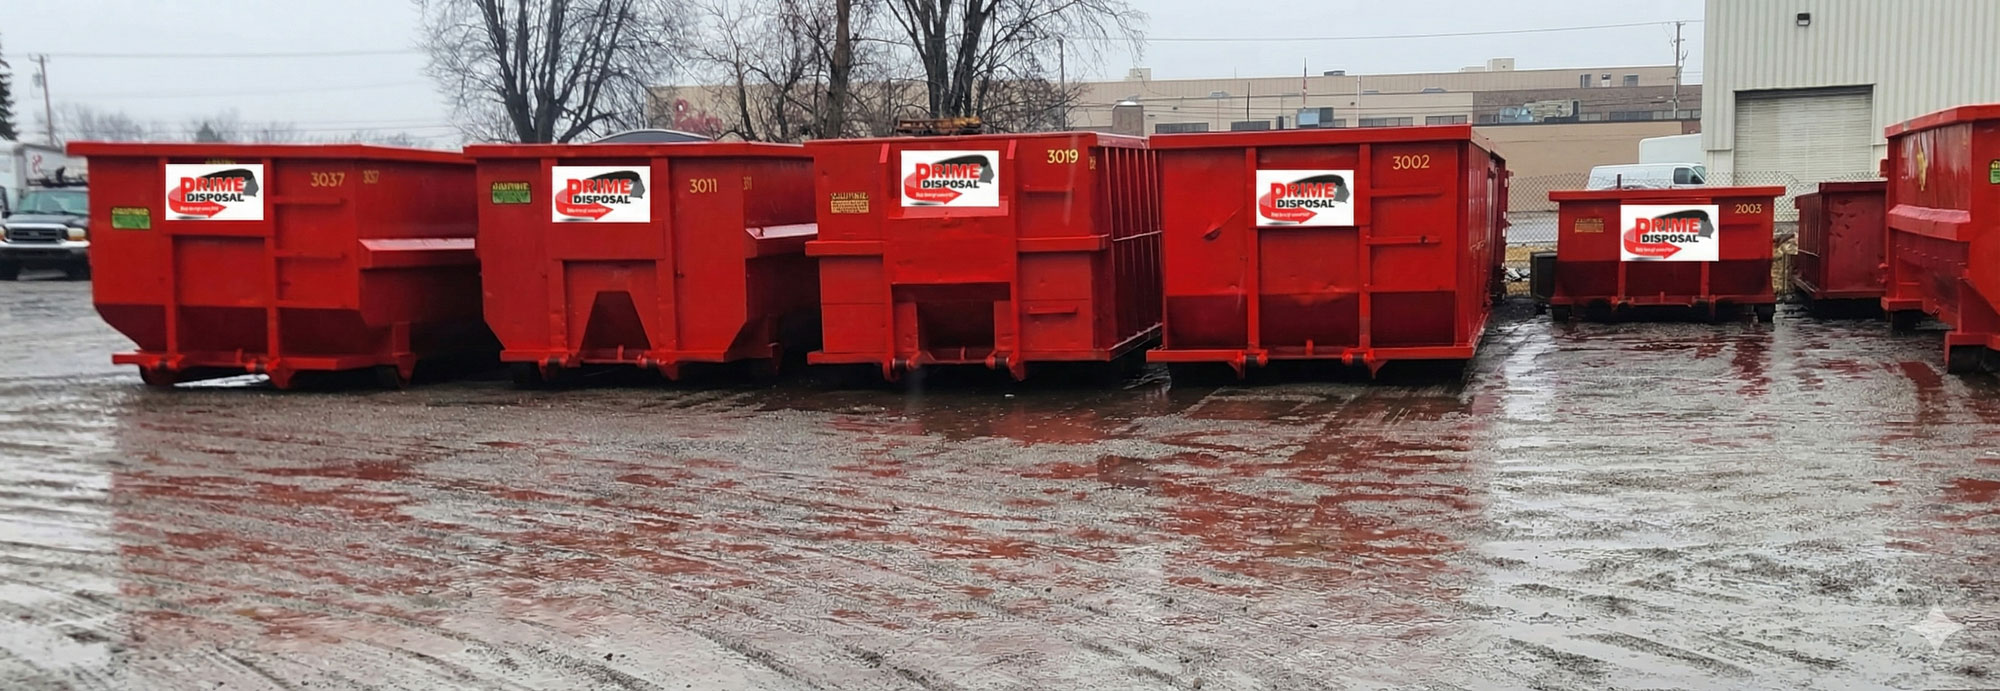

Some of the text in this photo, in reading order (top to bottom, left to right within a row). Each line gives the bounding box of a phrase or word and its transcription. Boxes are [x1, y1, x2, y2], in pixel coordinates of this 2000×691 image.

[1047, 149, 1079, 164] 3019
[1392, 154, 1430, 170] 3002
[311, 172, 345, 187] 3037
[915, 163, 981, 189] PRIME
[180, 177, 244, 203] PRIME
[567, 179, 632, 204] PRIME
[689, 178, 717, 193] 3011
[922, 180, 980, 189] DISPOSAL
[187, 193, 245, 202] DISPOSAL
[573, 195, 631, 204] DISPOSAL
[1271, 183, 1336, 209] PRIME
[1277, 200, 1335, 209] DISPOSAL
[1735, 203, 1762, 214] 2003
[1635, 218, 1700, 243] PRIME
[1642, 234, 1700, 243] DISPOSAL
